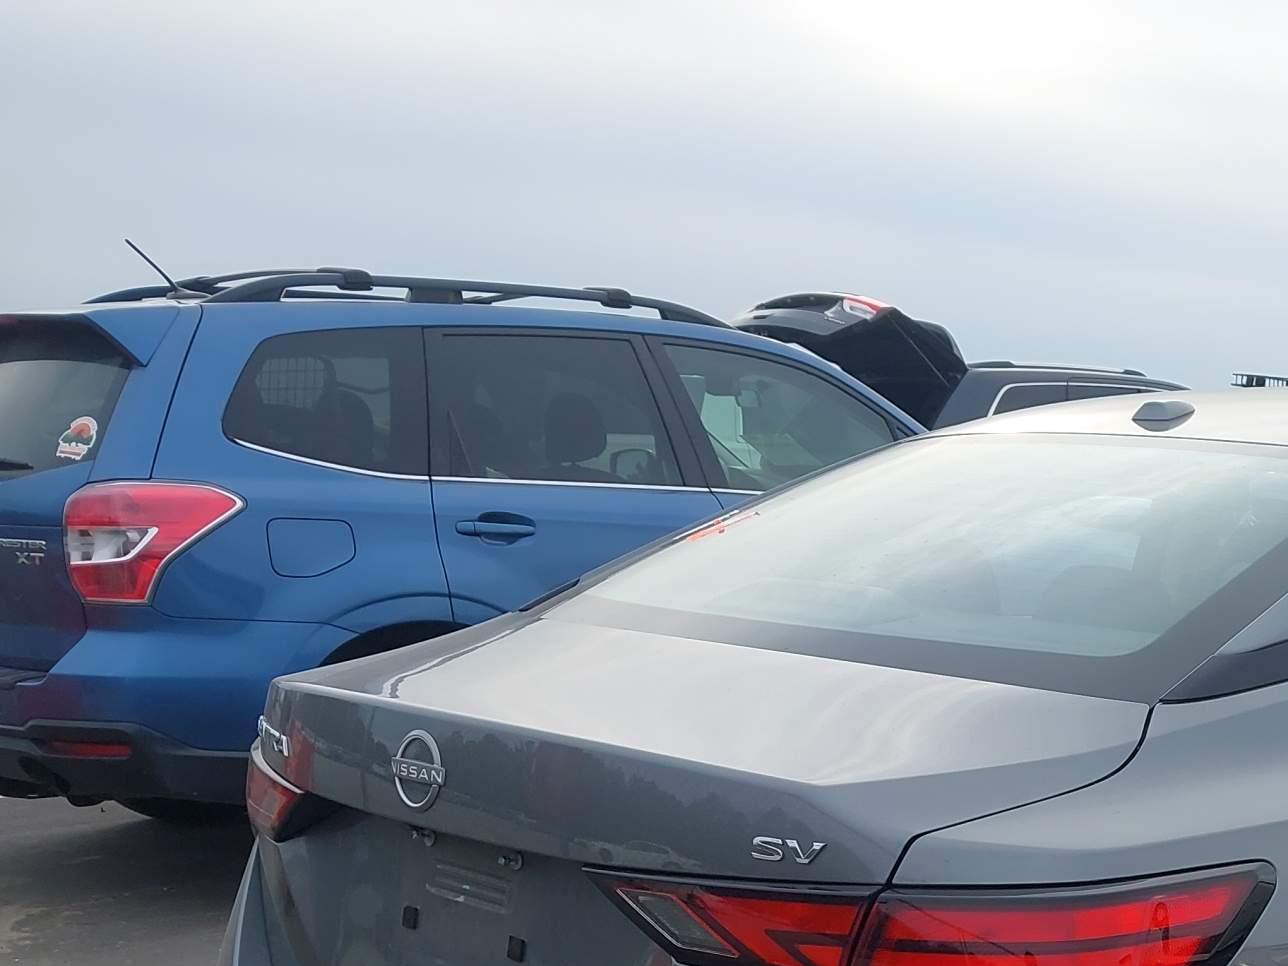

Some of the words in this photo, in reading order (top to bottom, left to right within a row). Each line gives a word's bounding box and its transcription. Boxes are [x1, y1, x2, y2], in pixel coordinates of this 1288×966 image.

[15, 551, 45, 565] XT
[391, 759, 443, 783] NISSAN
[751, 836, 826, 864] SV
